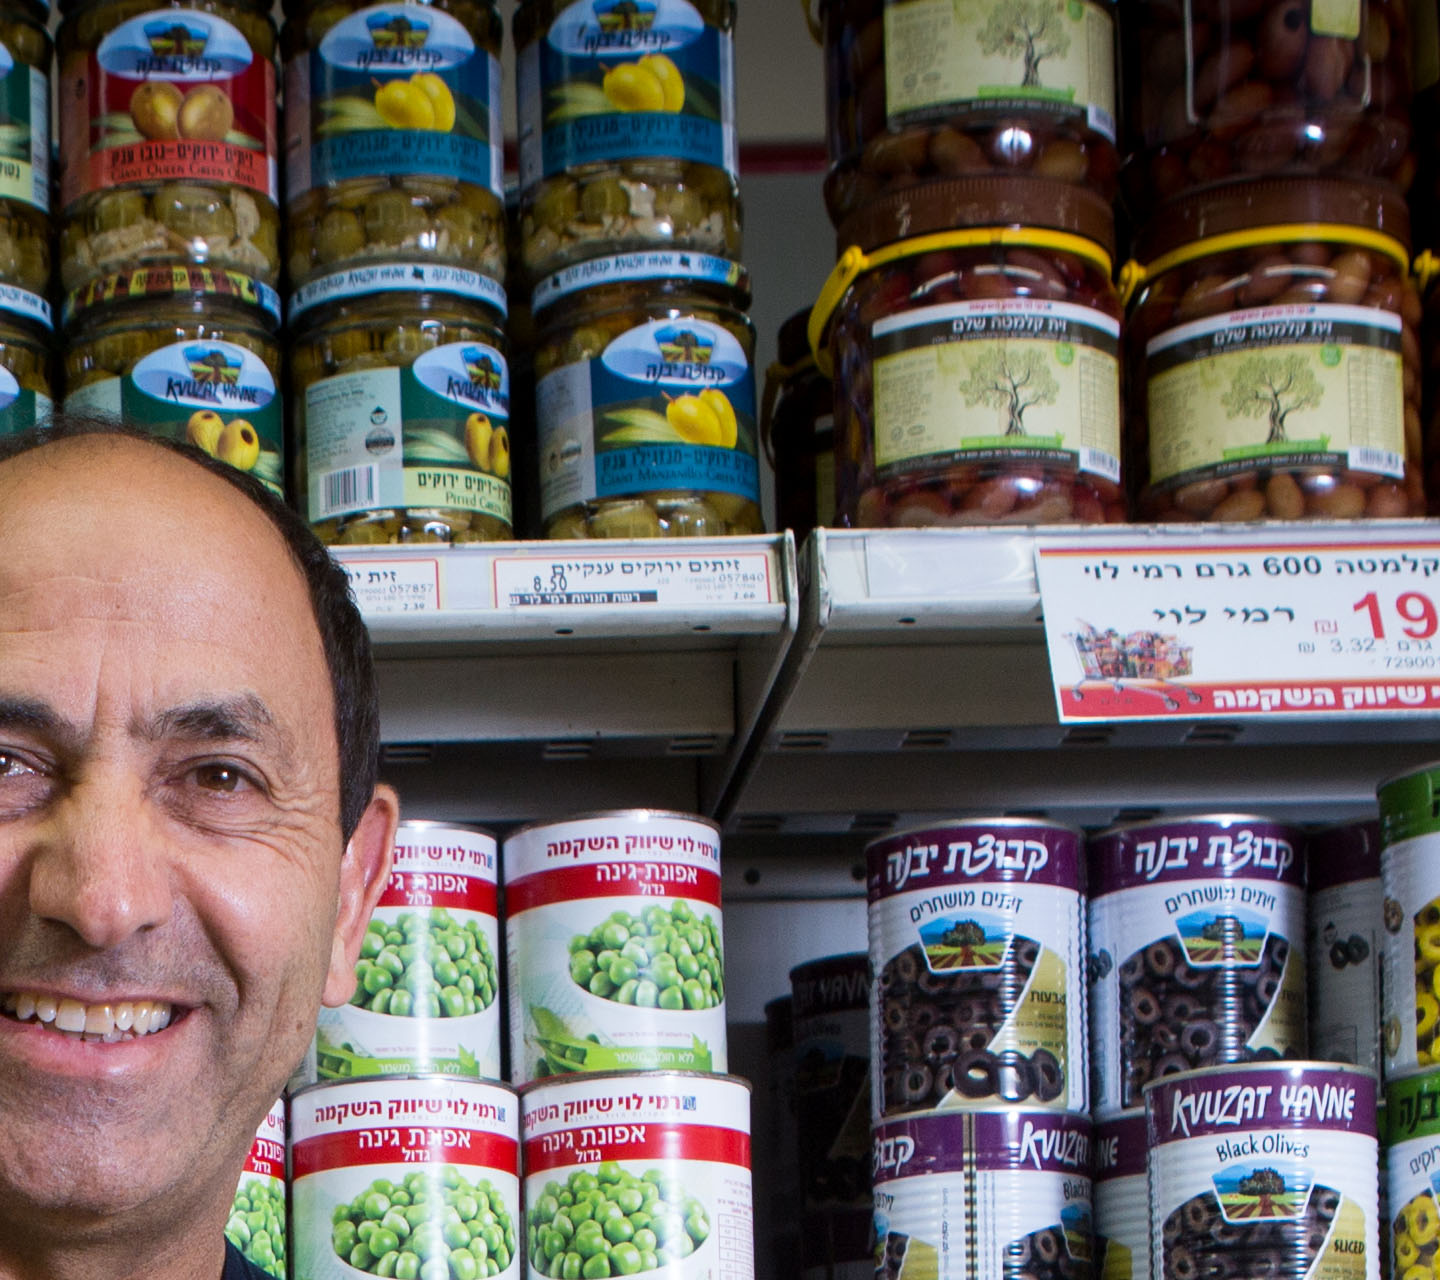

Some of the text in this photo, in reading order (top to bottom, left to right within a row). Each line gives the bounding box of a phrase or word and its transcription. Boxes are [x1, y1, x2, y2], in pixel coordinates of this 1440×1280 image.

[552, 559, 740, 578] זיתים ירוקים ענקיים
[1083, 558, 1122, 580] לוי
[1133, 561, 1183, 581] רמי
[1195, 558, 1253, 580] גרם
[1263, 555, 1322, 577] 600
[533, 576, 567, 592] 8.50
[1153, 608, 1295, 627] רמי לוי
[1352, 591, 1439, 641] 19
[1214, 685, 1331, 708] השקמה
[1343, 684, 1423, 708] שיווק
[886, 834, 1049, 882] קבוצת יבנה
[316, 1098, 498, 1125] רמי לוי שיווק השקמה
[1172, 1082, 1355, 1140] KVUZAT YAVNE
[359, 1127, 471, 1150] אפונת גינה
[1215, 1136, 1260, 1163] Black
[401, 1147, 431, 1162] גדול
